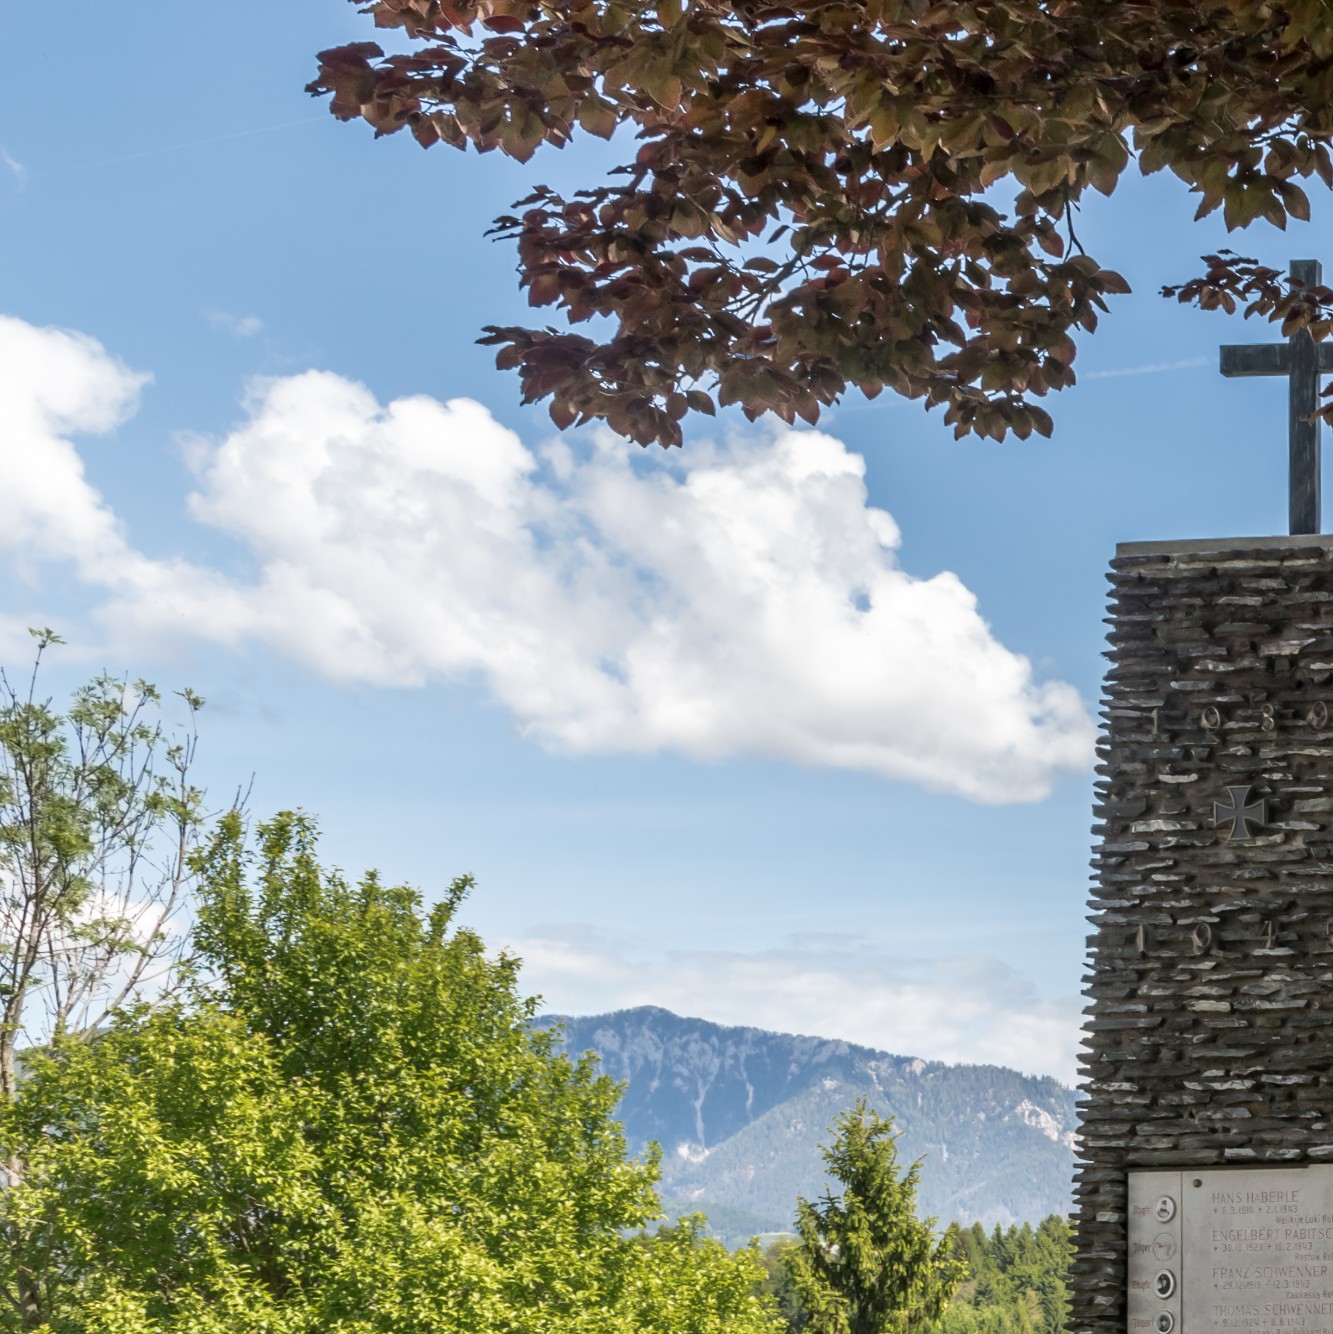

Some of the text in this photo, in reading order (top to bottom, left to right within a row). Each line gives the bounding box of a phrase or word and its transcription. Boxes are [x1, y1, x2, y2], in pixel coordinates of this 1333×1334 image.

[1212, 1192, 1242, 1204] HANS
[1212, 1228, 1281, 1241] ENGELBERT
[1212, 1265, 1328, 1279] FRANZ SCHWENNER
[1213, 1304, 1260, 1316] THOMAS
